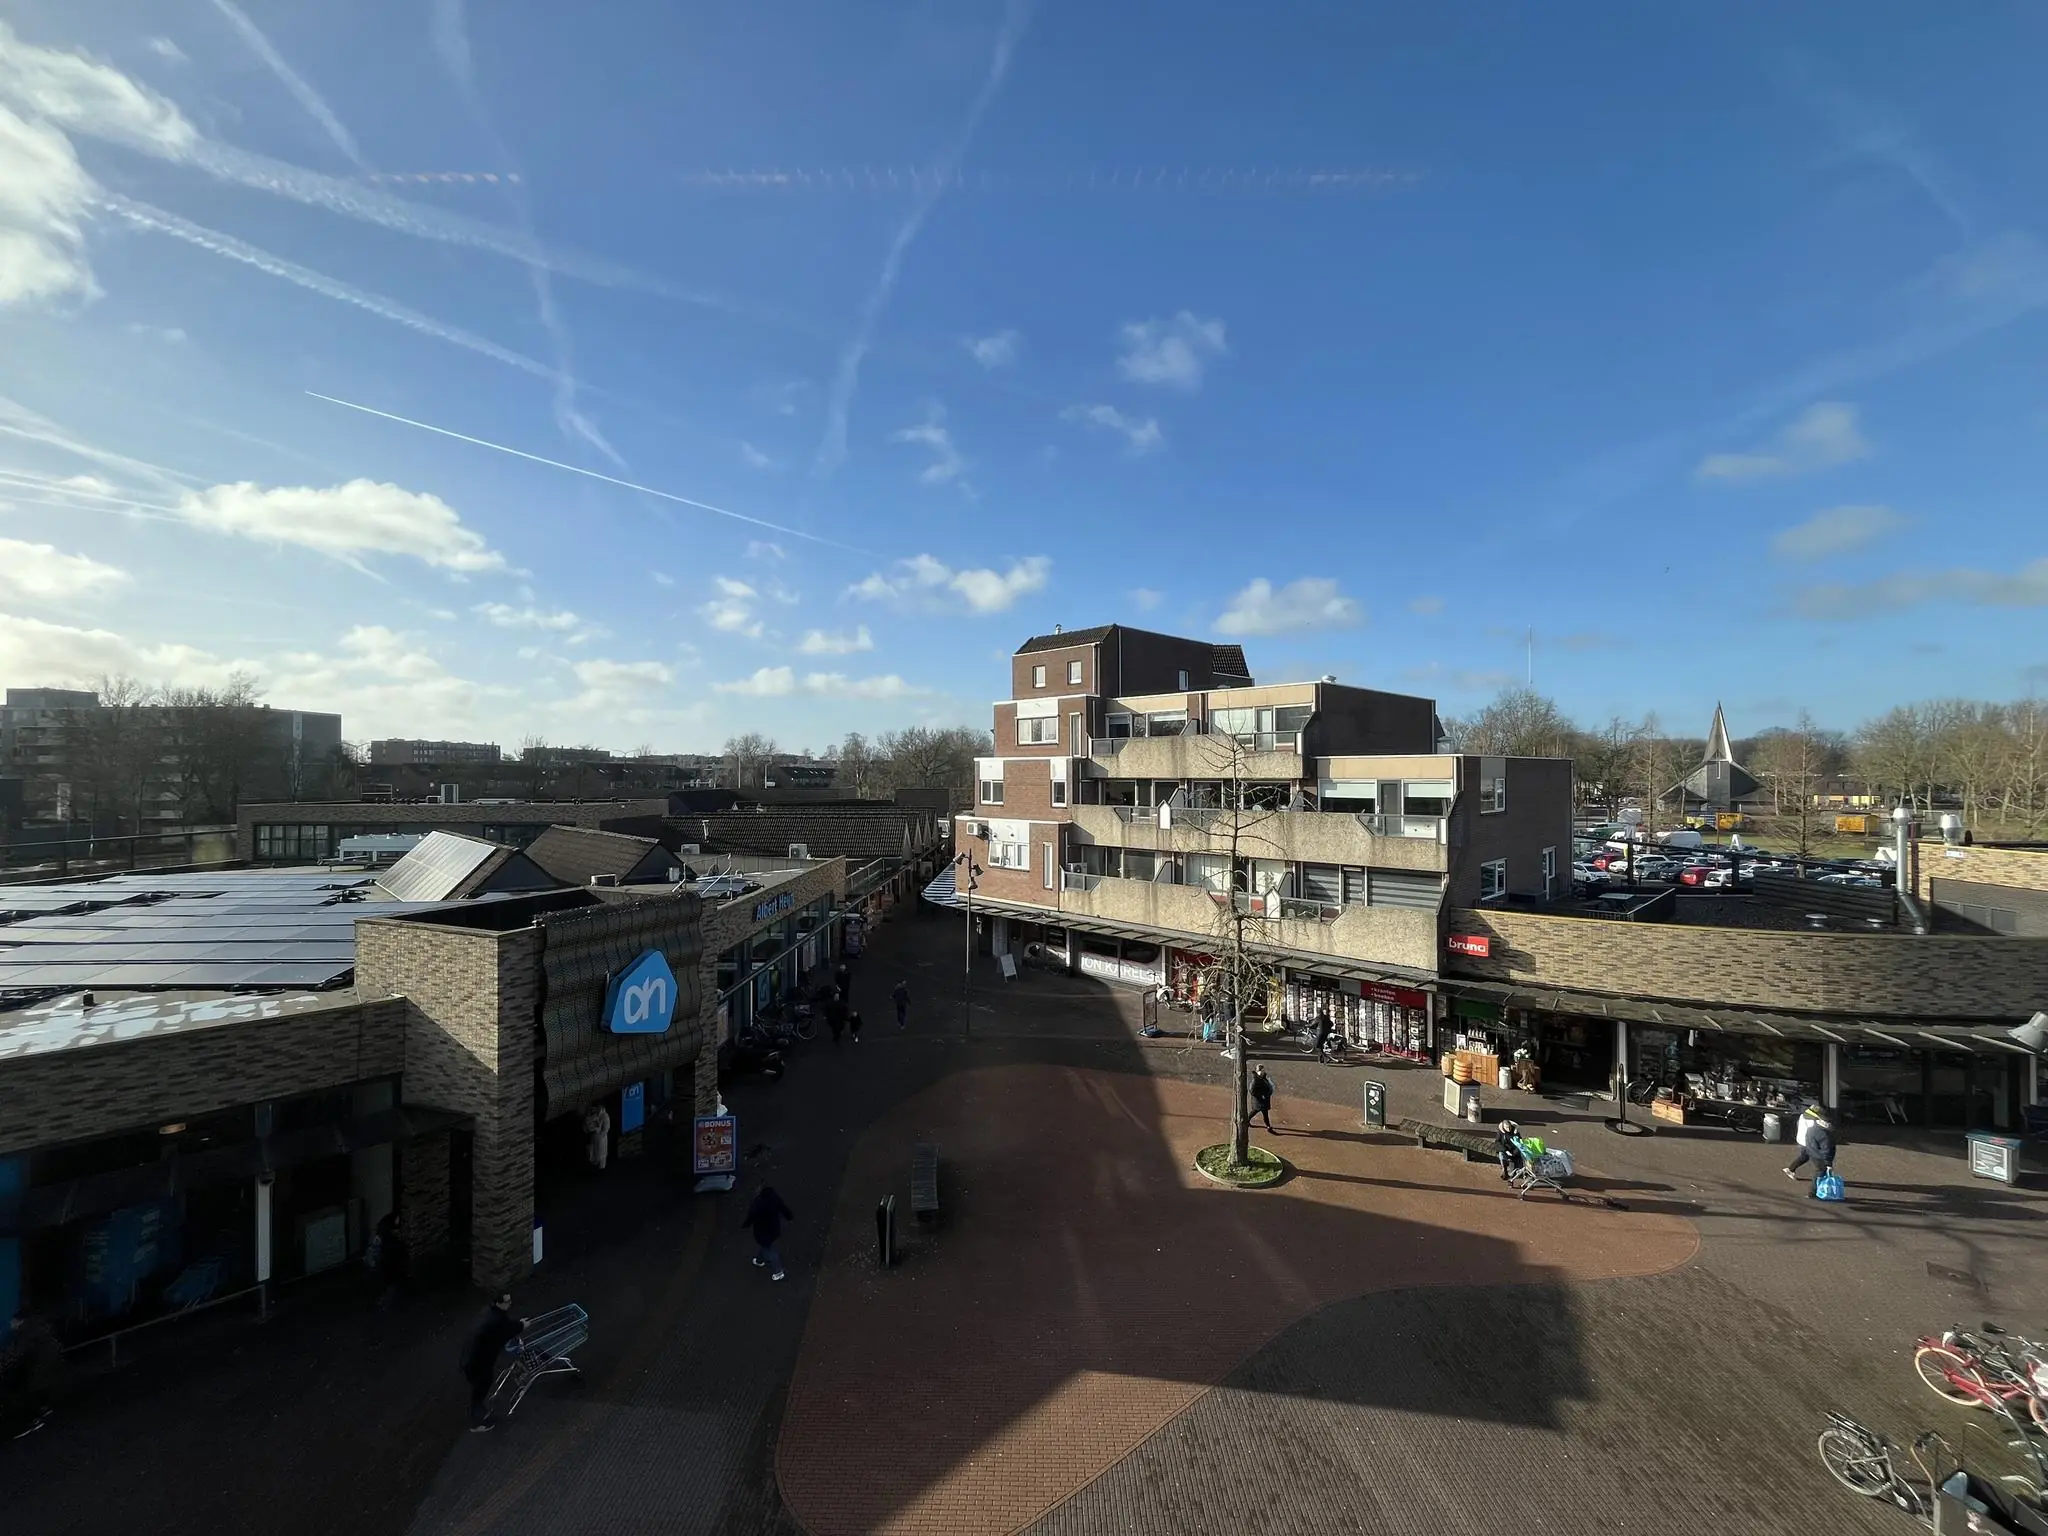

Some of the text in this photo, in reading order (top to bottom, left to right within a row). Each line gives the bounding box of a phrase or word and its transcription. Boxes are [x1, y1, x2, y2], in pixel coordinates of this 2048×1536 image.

[756, 897, 777, 921] Albert
[1449, 938, 1486, 952] bruna
[704, 1120, 731, 1128] BONUS
